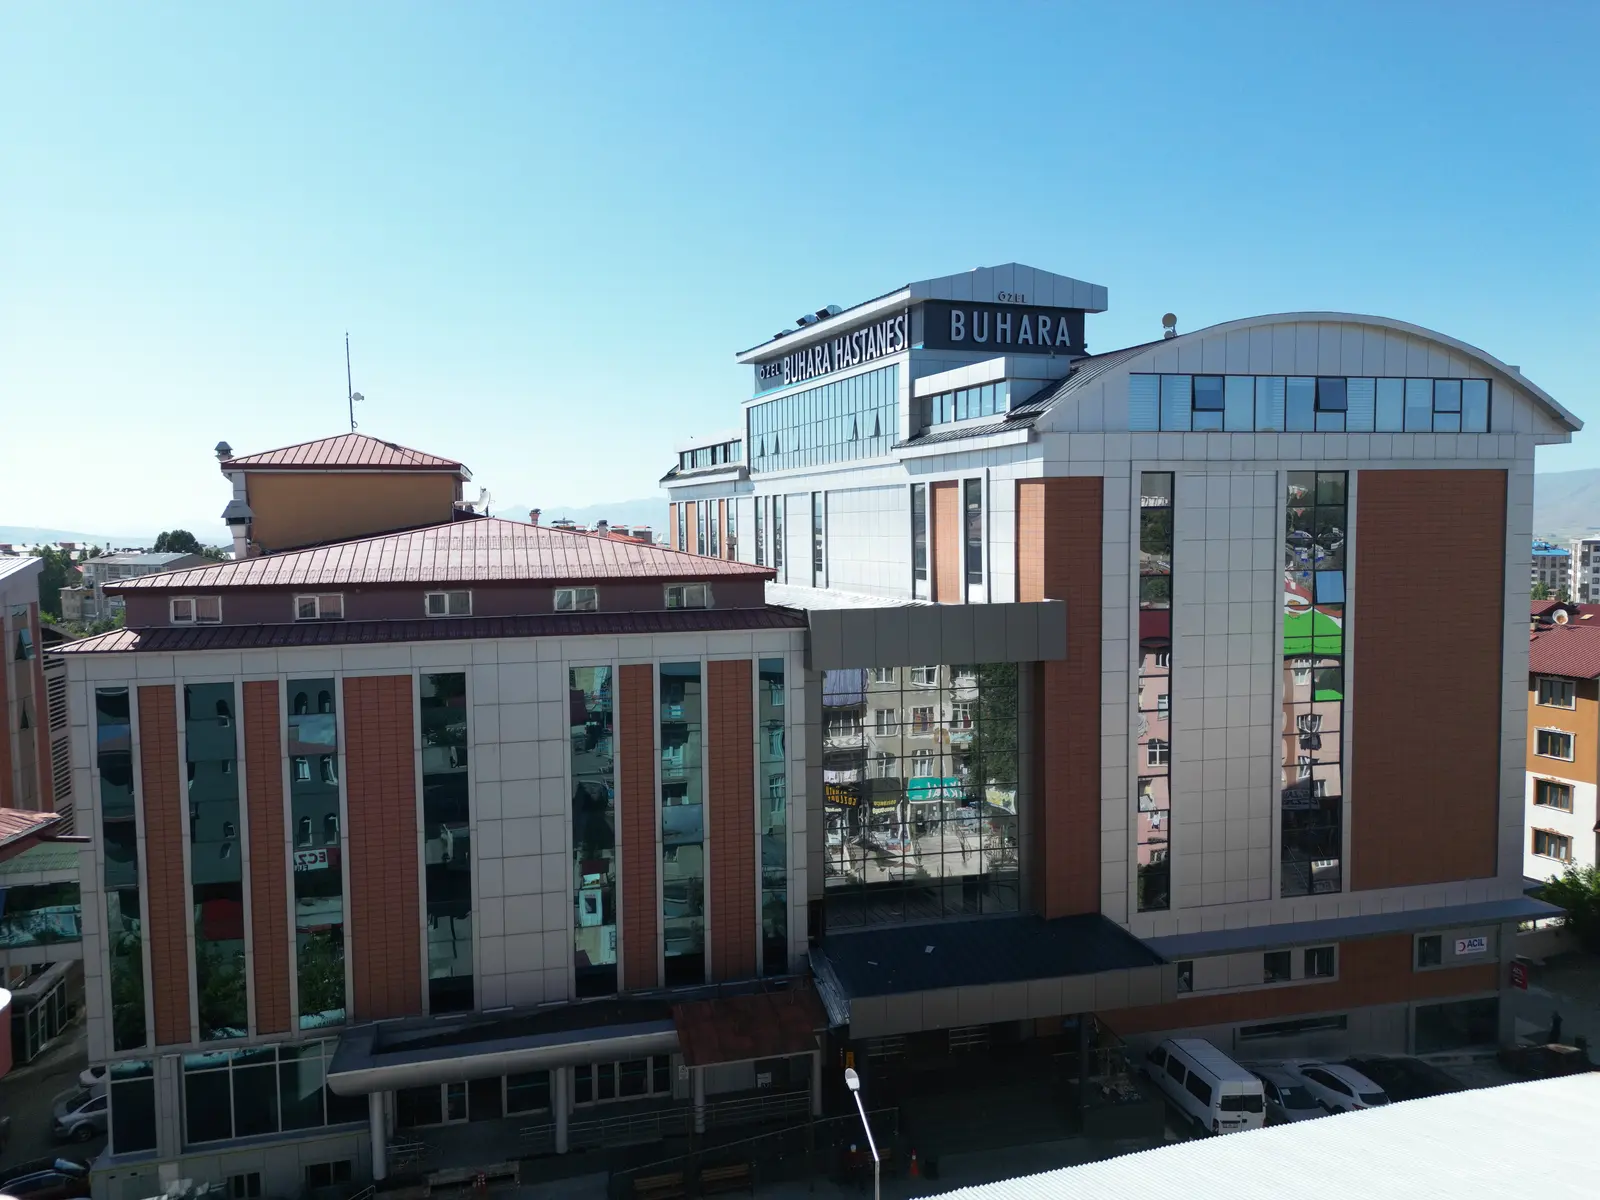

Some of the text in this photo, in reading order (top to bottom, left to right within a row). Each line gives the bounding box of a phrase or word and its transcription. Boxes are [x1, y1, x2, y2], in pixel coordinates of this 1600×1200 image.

[998, 291, 1028, 303] ÖZEL
[759, 307, 908, 385] ÖZEL BUHARA HASTANESİ
[951, 309, 1071, 347] BUHARA
